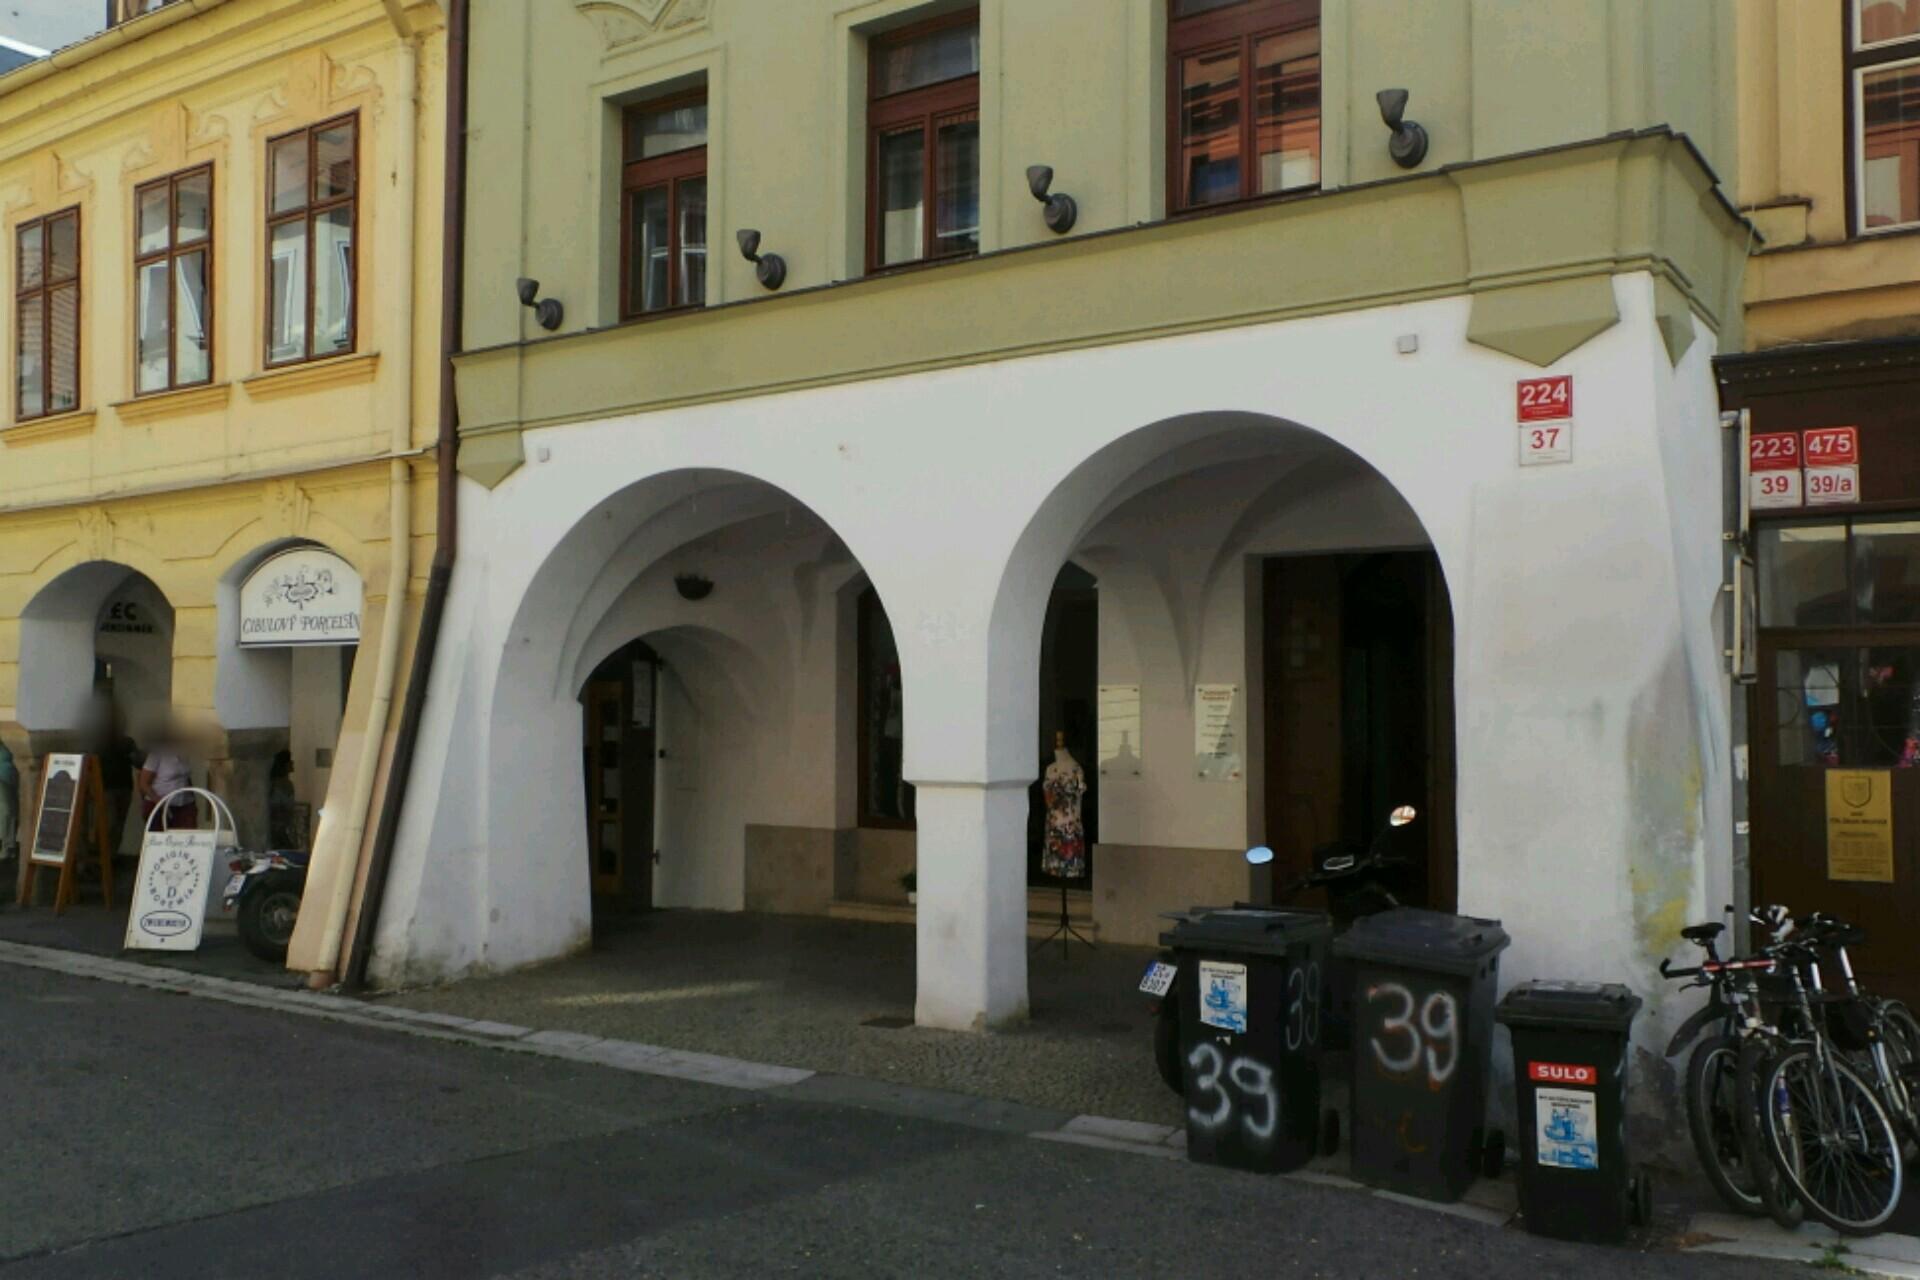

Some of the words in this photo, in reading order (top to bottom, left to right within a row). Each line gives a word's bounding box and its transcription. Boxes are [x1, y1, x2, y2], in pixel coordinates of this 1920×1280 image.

[1521, 381, 1568, 407] 224
[1531, 428, 1560, 449] 37
[1751, 437, 1796, 459] 223
[1809, 434, 1852, 454] 475
[1761, 475, 1789, 495] 39
[1810, 474, 1852, 494] 39/a
[1366, 982, 1459, 1083] 39
[1537, 1065, 1589, 1080] SULO
[1188, 1042, 1278, 1138] 39
